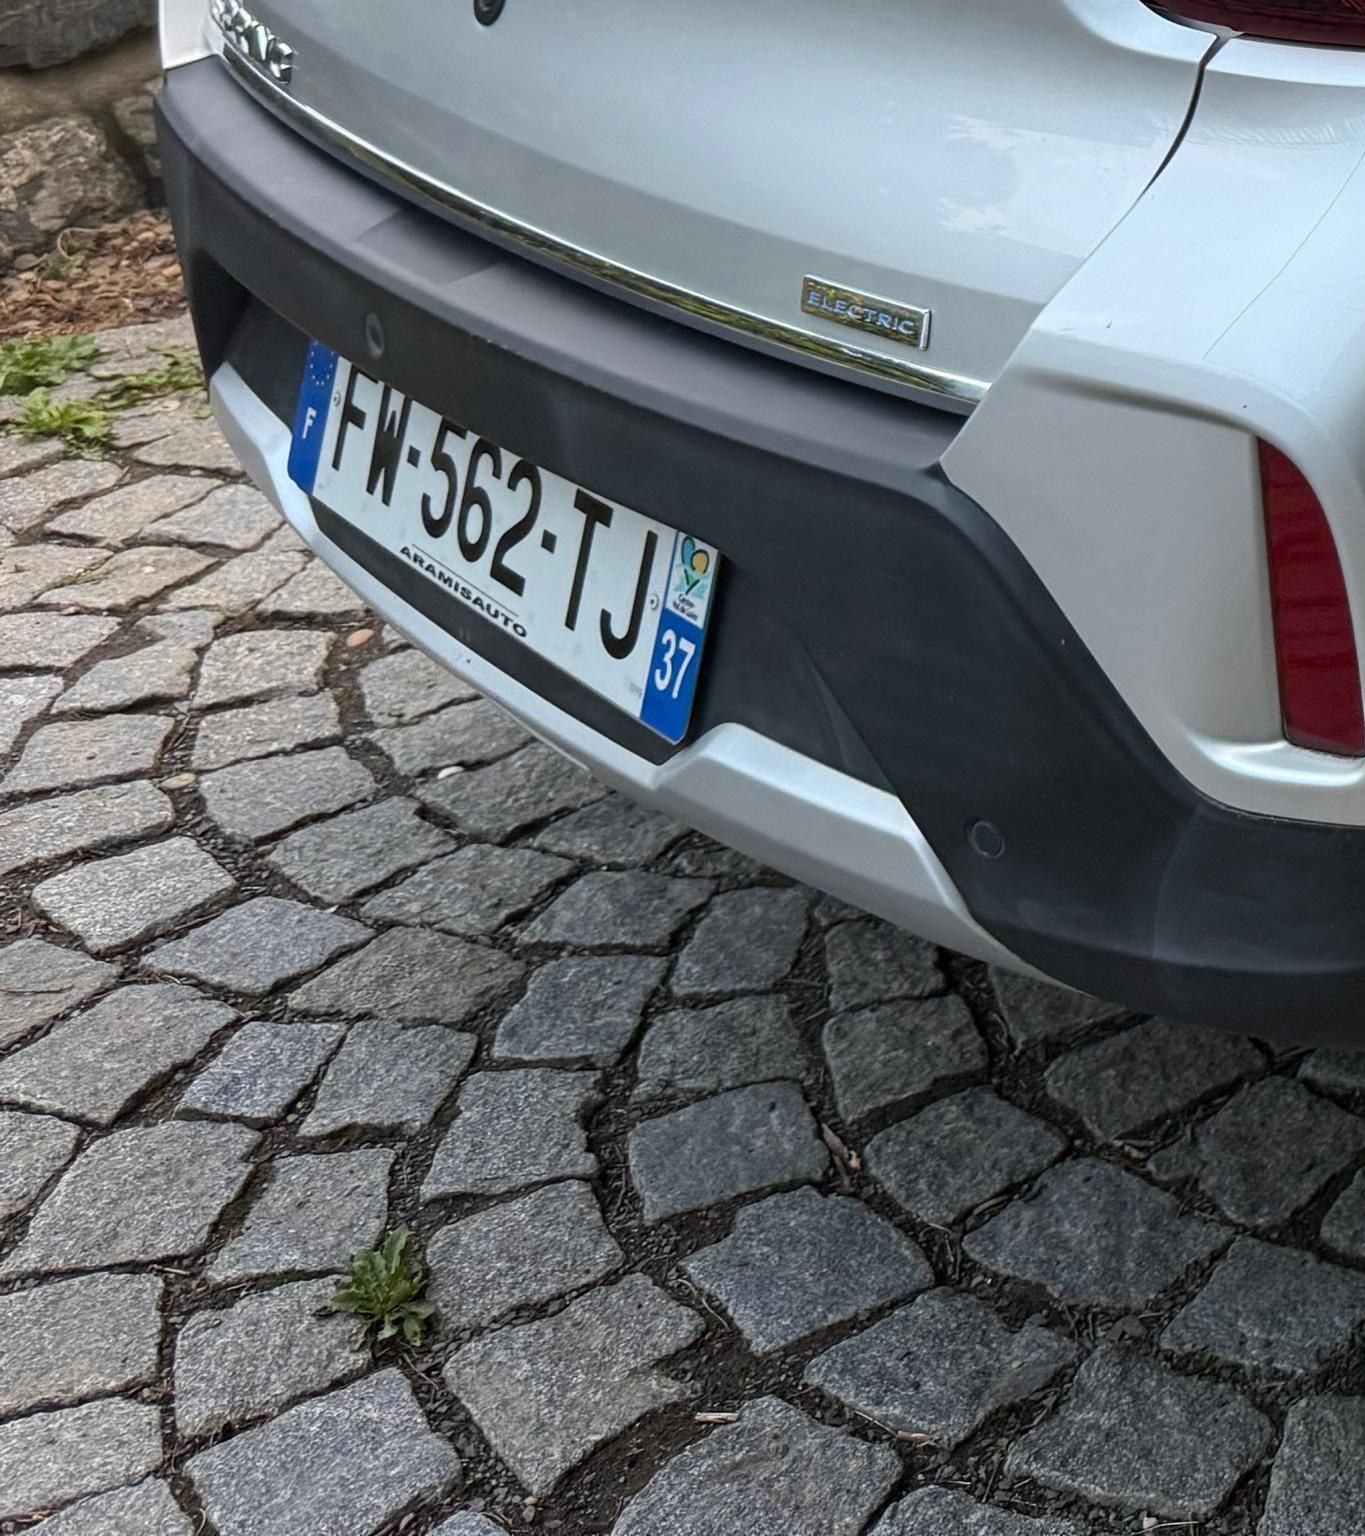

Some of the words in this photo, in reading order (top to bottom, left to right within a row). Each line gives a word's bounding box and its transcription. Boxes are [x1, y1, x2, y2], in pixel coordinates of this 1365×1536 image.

[807, 291, 914, 335] ELECTRIC
[302, 407, 316, 439] F
[332, 365, 658, 660] FW-562-TJ
[400, 546, 527, 638] ARAMISAUTO
[654, 628, 696, 700] 37
